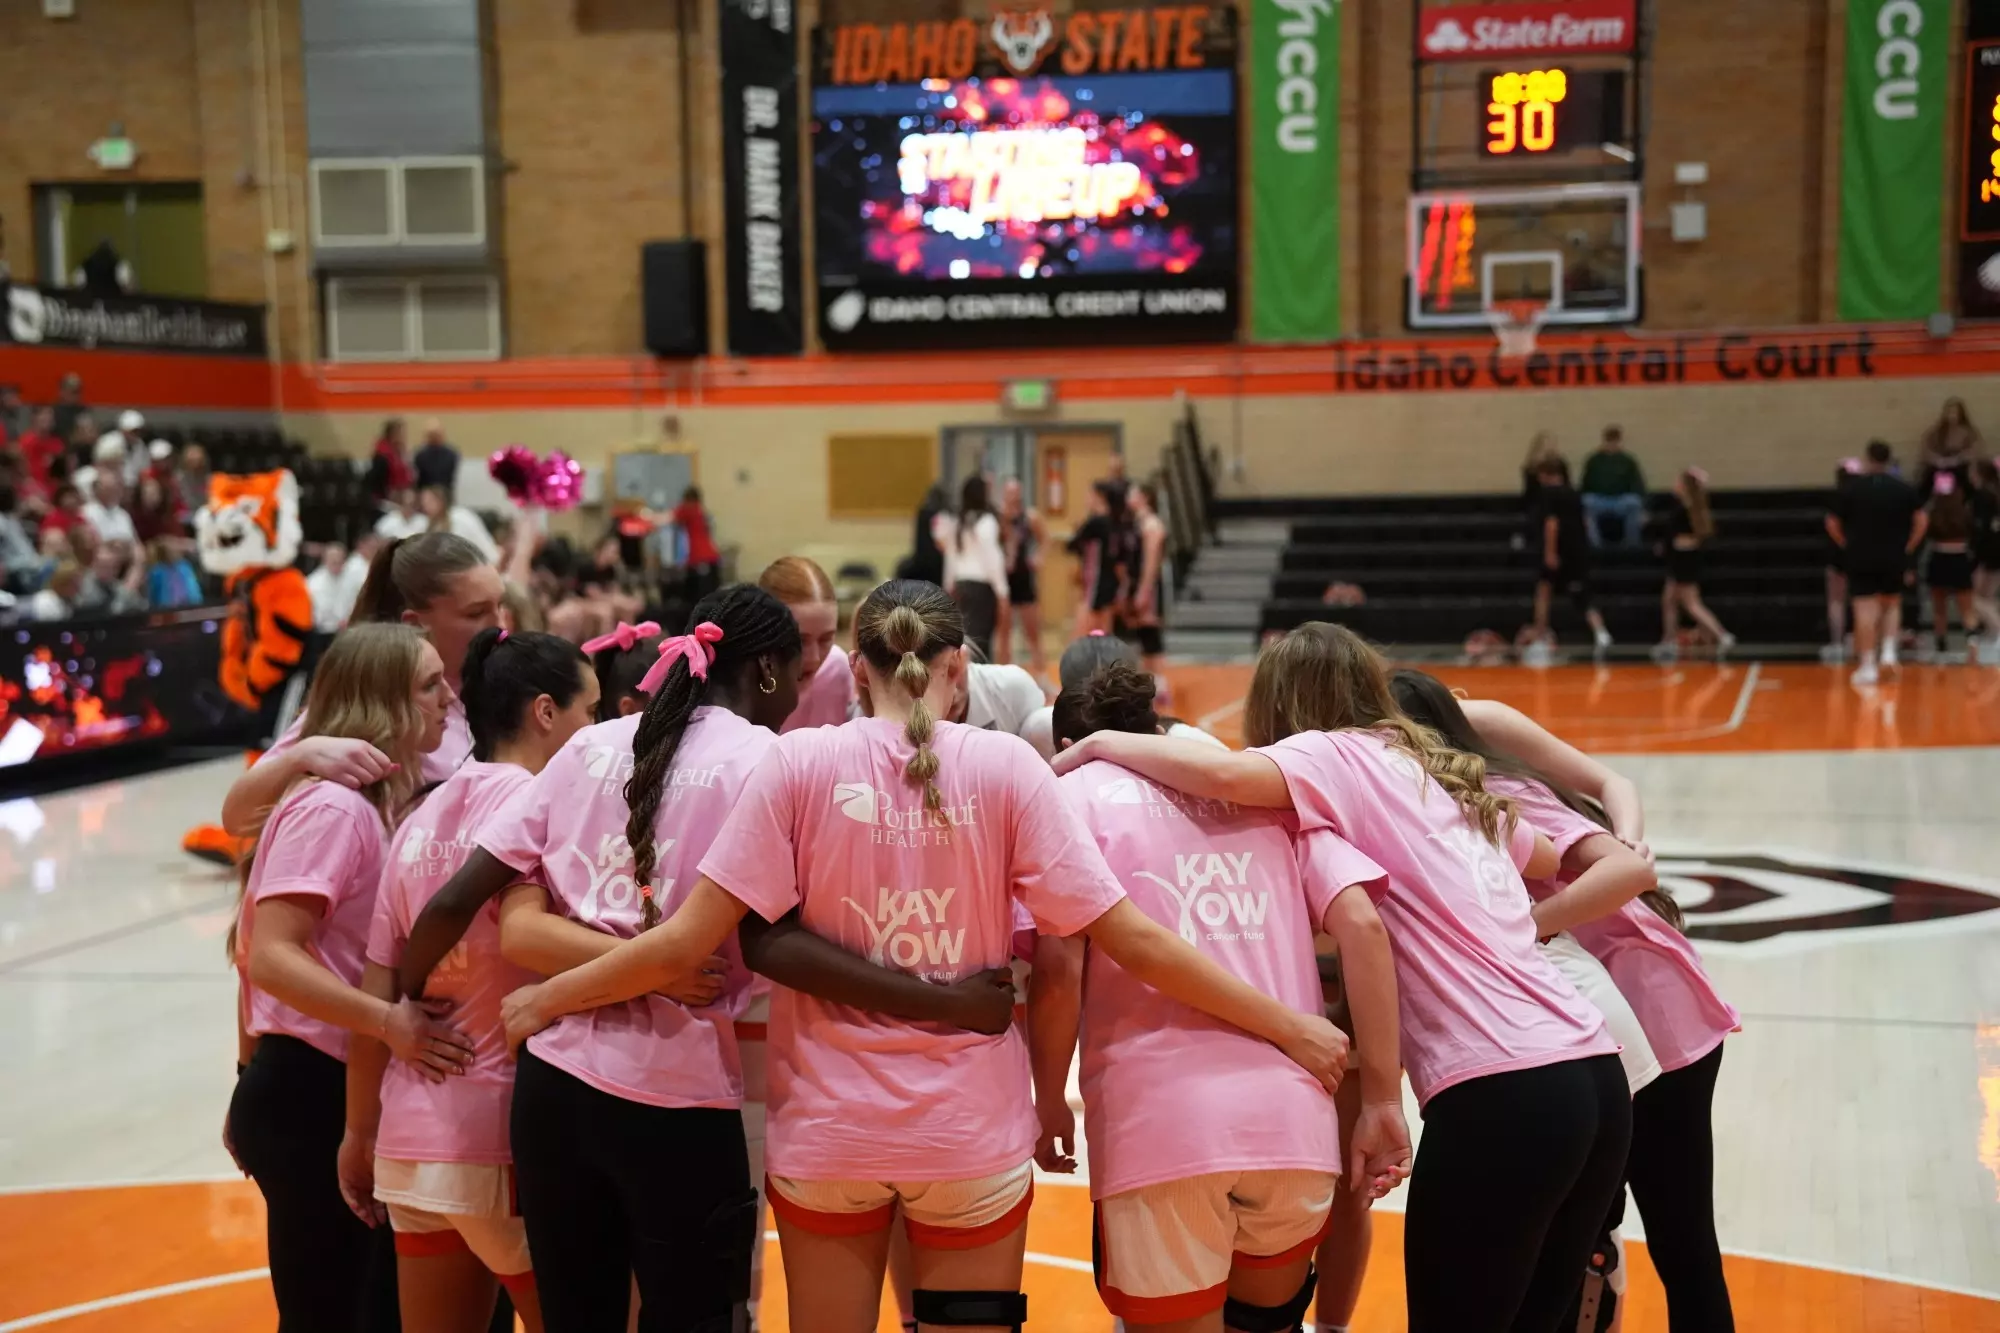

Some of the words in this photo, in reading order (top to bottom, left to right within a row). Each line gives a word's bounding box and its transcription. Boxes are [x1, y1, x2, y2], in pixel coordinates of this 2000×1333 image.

[832, 19, 977, 84] IDAHO
[1061, 8, 1206, 74] STATE
[742, 85, 780, 134] DR.
[1487, 101, 1555, 154] 30
[744, 136, 781, 217] MARK
[746, 220, 784, 312] BAKER
[869, 297, 946, 322] IDAHO
[946, 294, 1053, 321] CENTRAL
[1055, 290, 1140, 318] CREDIT
[1143, 287, 1227, 314] UNION
[1334, 344, 1478, 391] Idaho
[1486, 338, 1686, 387] Central
[1715, 332, 1877, 380] Court
[608, 751, 724, 788] Poneuf
[1148, 803, 1240, 819] HEALTH
[871, 827, 950, 848] HEALTH
[1174, 852, 1253, 887] KAY
[877, 886, 957, 926] KAY
[1131, 870, 1269, 948] YOW
[840, 896, 966, 968] YOW
